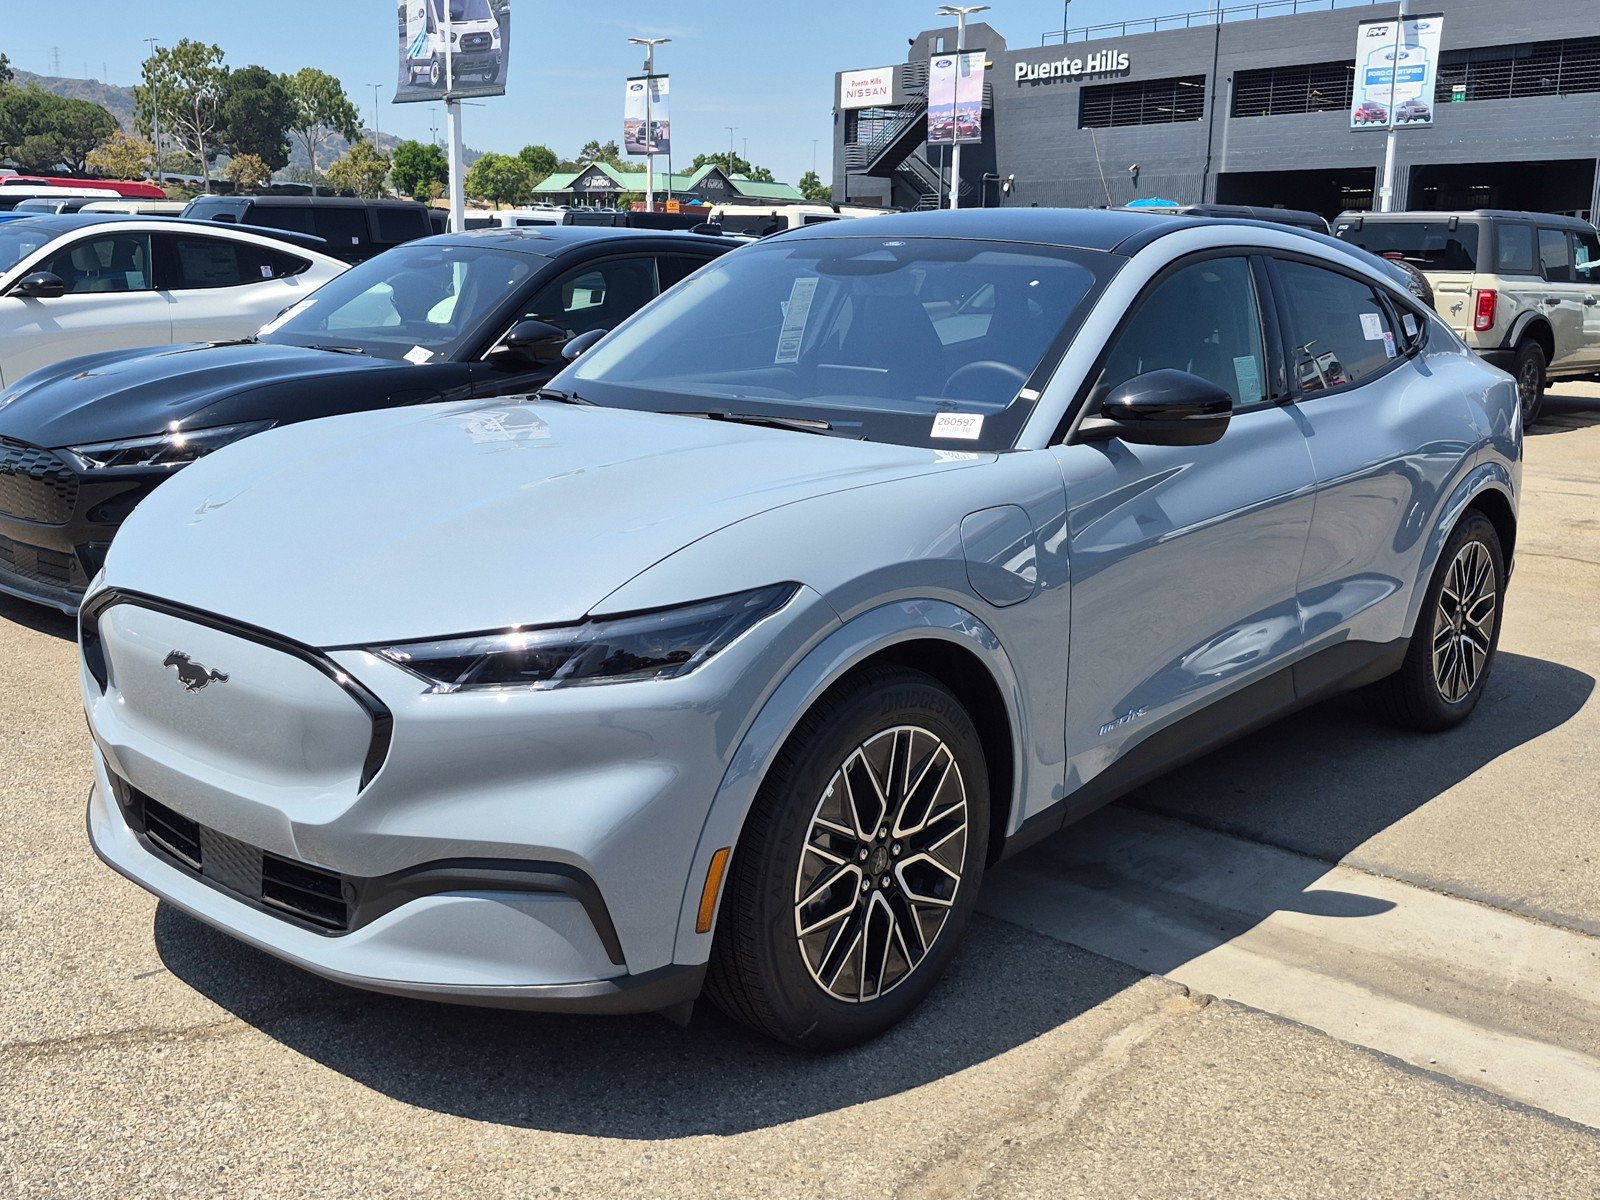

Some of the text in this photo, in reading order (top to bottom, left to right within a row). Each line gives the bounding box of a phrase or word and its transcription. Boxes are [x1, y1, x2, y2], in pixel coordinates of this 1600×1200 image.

[1015, 50, 1129, 80] Puente Hills
[870, 77, 882, 85] Hills
[846, 87, 887, 98] NISSAN
[938, 417, 975, 427] 260597
[880, 688, 970, 739] BRIDGESTONE
